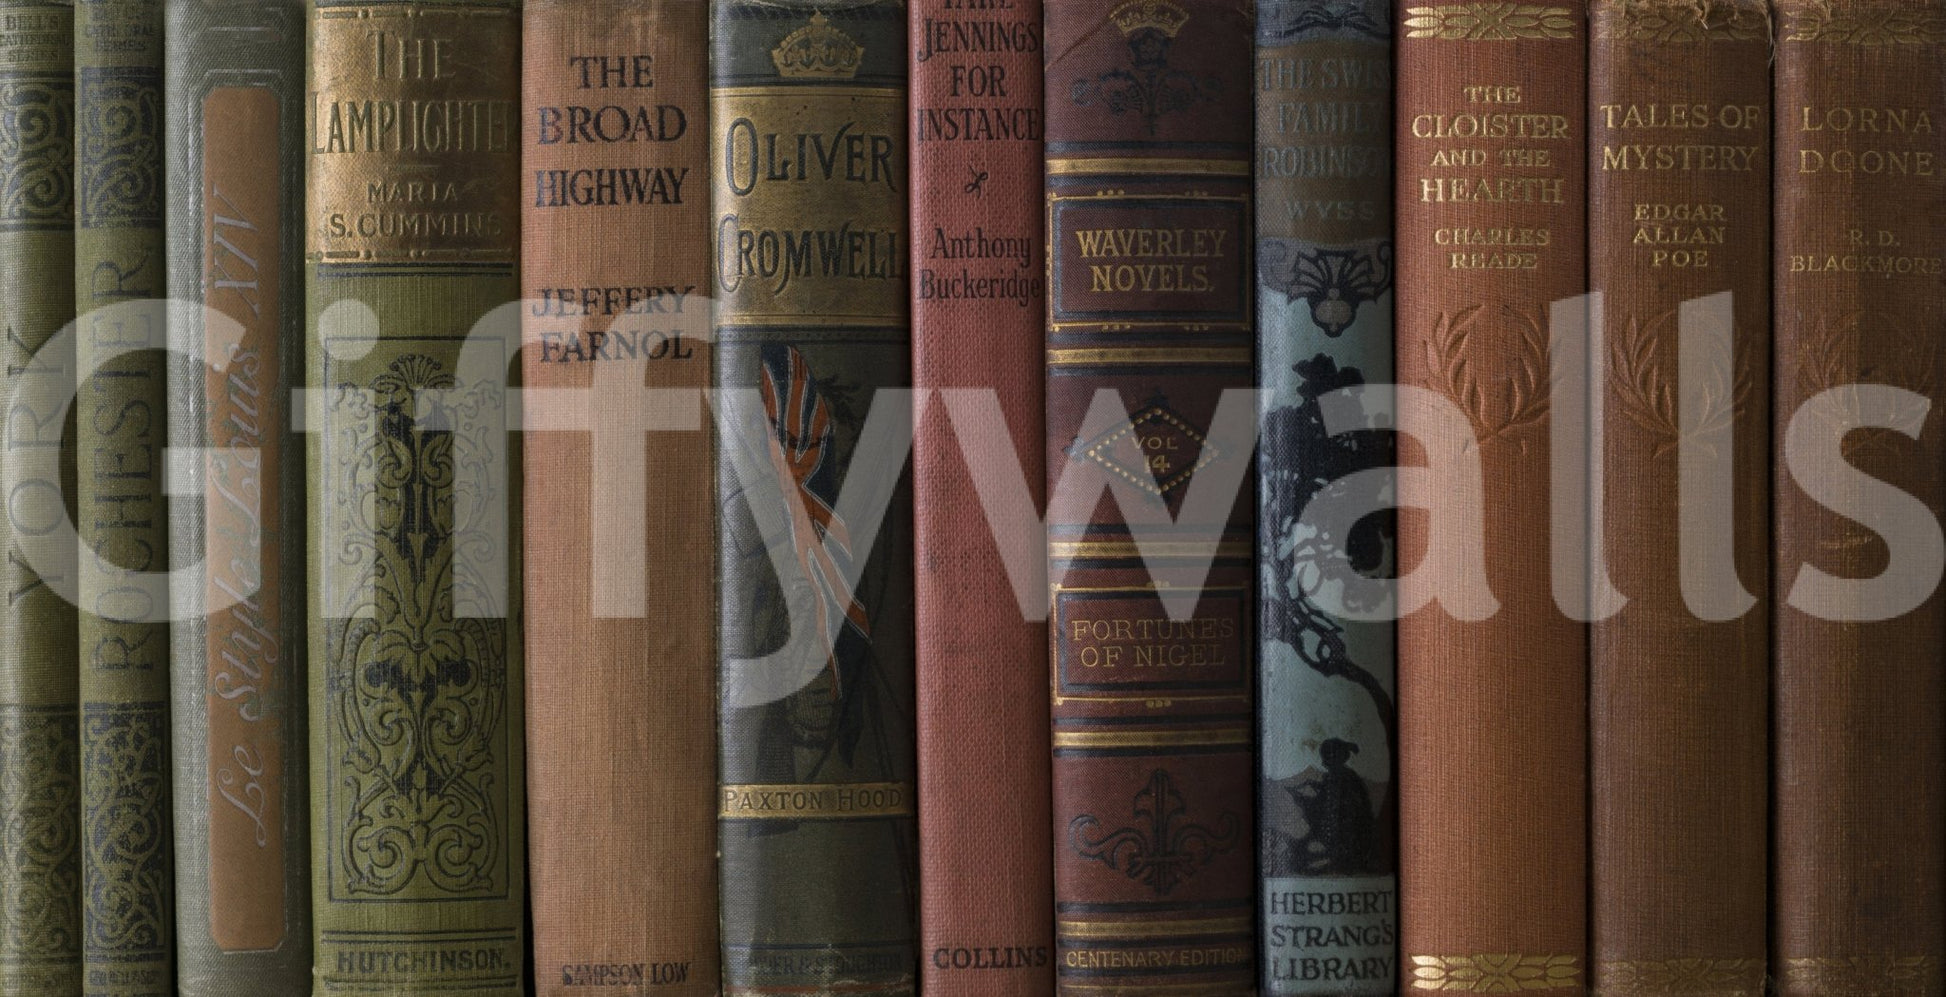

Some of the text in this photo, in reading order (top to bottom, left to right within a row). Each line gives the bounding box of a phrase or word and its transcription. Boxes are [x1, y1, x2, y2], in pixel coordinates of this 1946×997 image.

[916, 17, 1039, 62] JENNINGS
[366, 30, 456, 79] THE
[570, 55, 653, 90] THE
[950, 65, 1006, 98] FOR
[1260, 58, 1391, 91] THE SWIS
[1463, 85, 1521, 104] THE
[537, 104, 688, 145] BROAD
[917, 107, 1040, 142] INSTANCE
[1411, 113, 1572, 139] CLOISTER
[1600, 103, 1762, 129] TALES OF
[1801, 106, 1933, 134] LORNA
[725, 117, 898, 197] OLIVER
[1430, 149, 1551, 167] AND THE
[1601, 145, 1760, 171] MYSTERY
[1798, 149, 1935, 176] DOONE
[367, 180, 458, 203] MARIA
[535, 167, 690, 207] HIGHWAY
[1420, 177, 1565, 203] HEARTH
[1285, 200, 1376, 221] WYSS
[1633, 203, 1727, 221] EDGAR
[930, 225, 1032, 269] Anthony
[1075, 228, 1228, 258] WAVERLEY
[1434, 227, 1550, 246] CHARLES
[1633, 226, 1726, 244] ALLAN
[1850, 228, 1901, 247] R. D.
[212, 184, 264, 320] XIV
[717, 212, 902, 296] CROMWELL
[1449, 252, 1538, 269] READE
[1652, 250, 1709, 267] POE
[1789, 255, 1944, 275] BLACKMORE
[919, 268, 1042, 308] Buckeridge
[1088, 264, 1216, 292] NOVELS.
[532, 285, 696, 317] JEFFERY
[539, 328, 694, 364] FARNOL
[1130, 436, 1179, 451] VOL
[6, 325, 64, 607] YORK
[90, 254, 153, 672] ROCHESTER
[1142, 454, 1171, 474] 14
[1071, 617, 1235, 642] FORTUNES
[1081, 643, 1226, 668] OF NIGEL
[216, 744, 268, 848] Le
[723, 787, 902, 812] PAXTON HOOD
[1269, 891, 1394, 916] HERBERT
[1270, 918, 1395, 950] STRANG'S
[337, 948, 512, 974] HUTCHINSON.
[932, 946, 1048, 970] COLLINS
[1065, 949, 1175, 968] CENTENARY
[1270, 956, 1394, 982] LIBRARY
[561, 962, 693, 987] SAMPSON LOW
